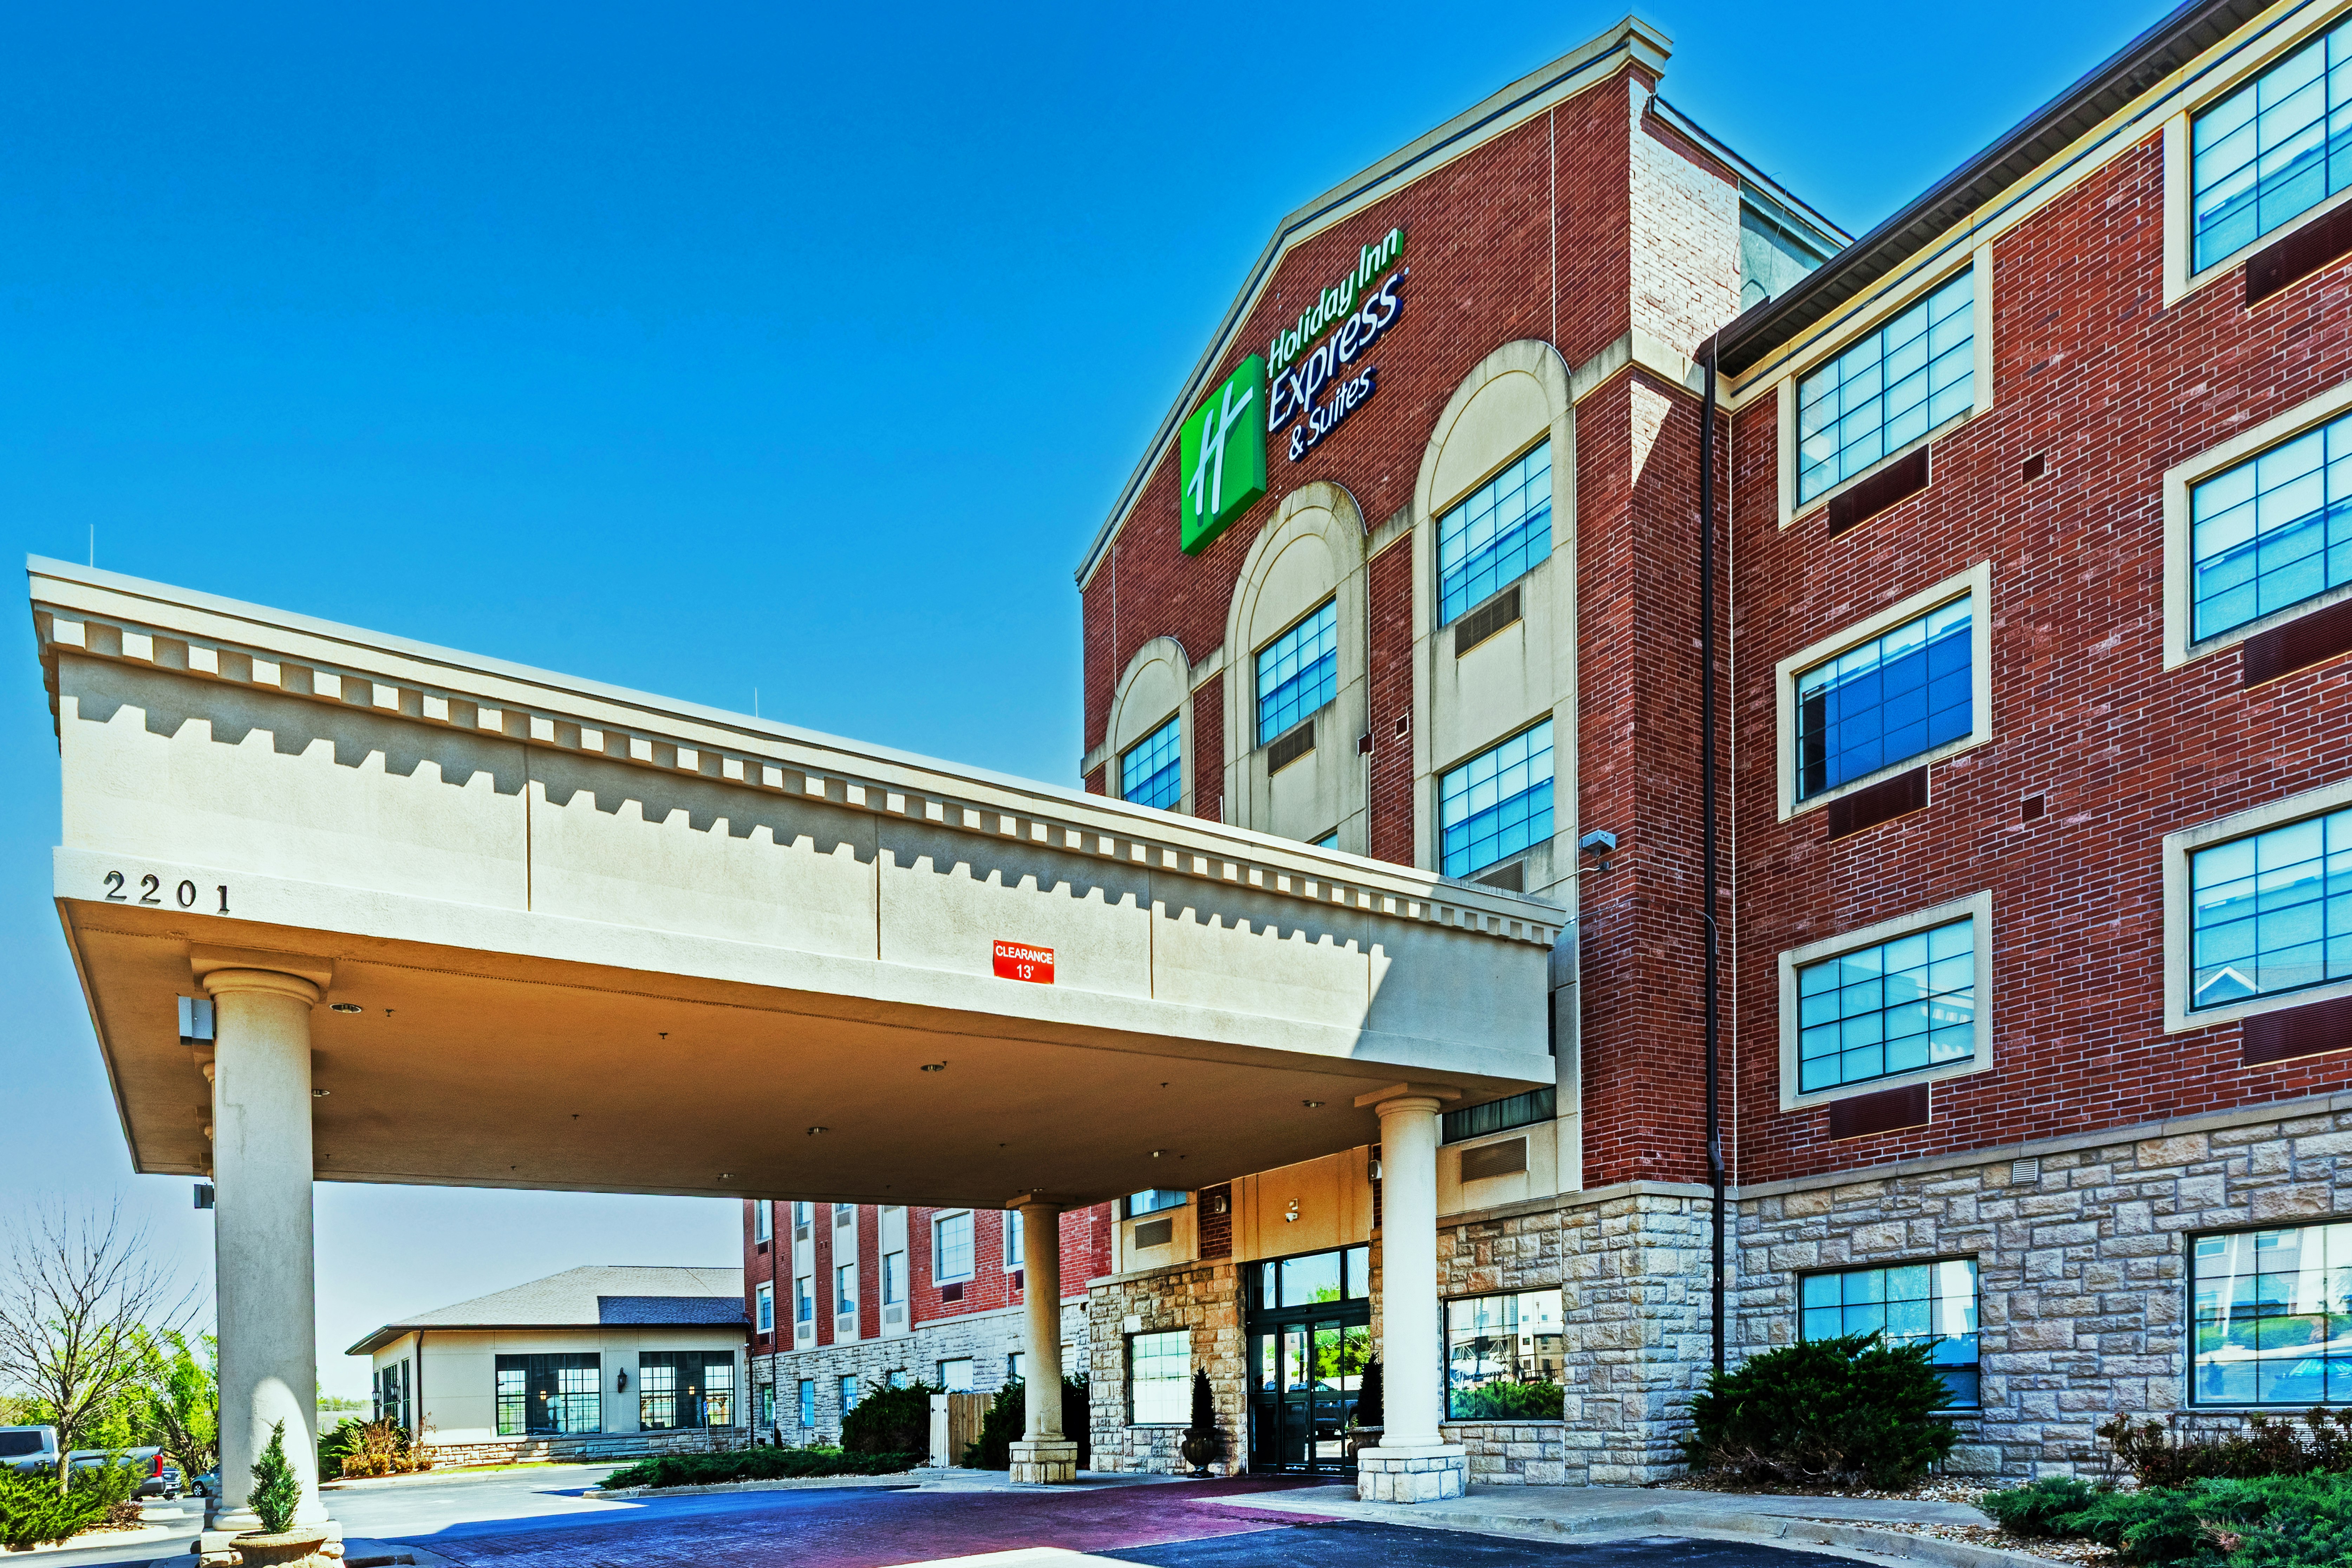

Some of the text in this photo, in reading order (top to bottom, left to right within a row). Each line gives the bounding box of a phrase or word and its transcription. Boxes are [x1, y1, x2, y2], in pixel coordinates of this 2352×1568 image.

[1267, 228, 1398, 379] Holiday Inn
[1269, 273, 1398, 432] Express
[1289, 366, 1372, 461] & Suites
[104, 870, 230, 912] 2201
[995, 945, 1053, 964] CLEARANCE
[1016, 964, 1034, 979] 13'
